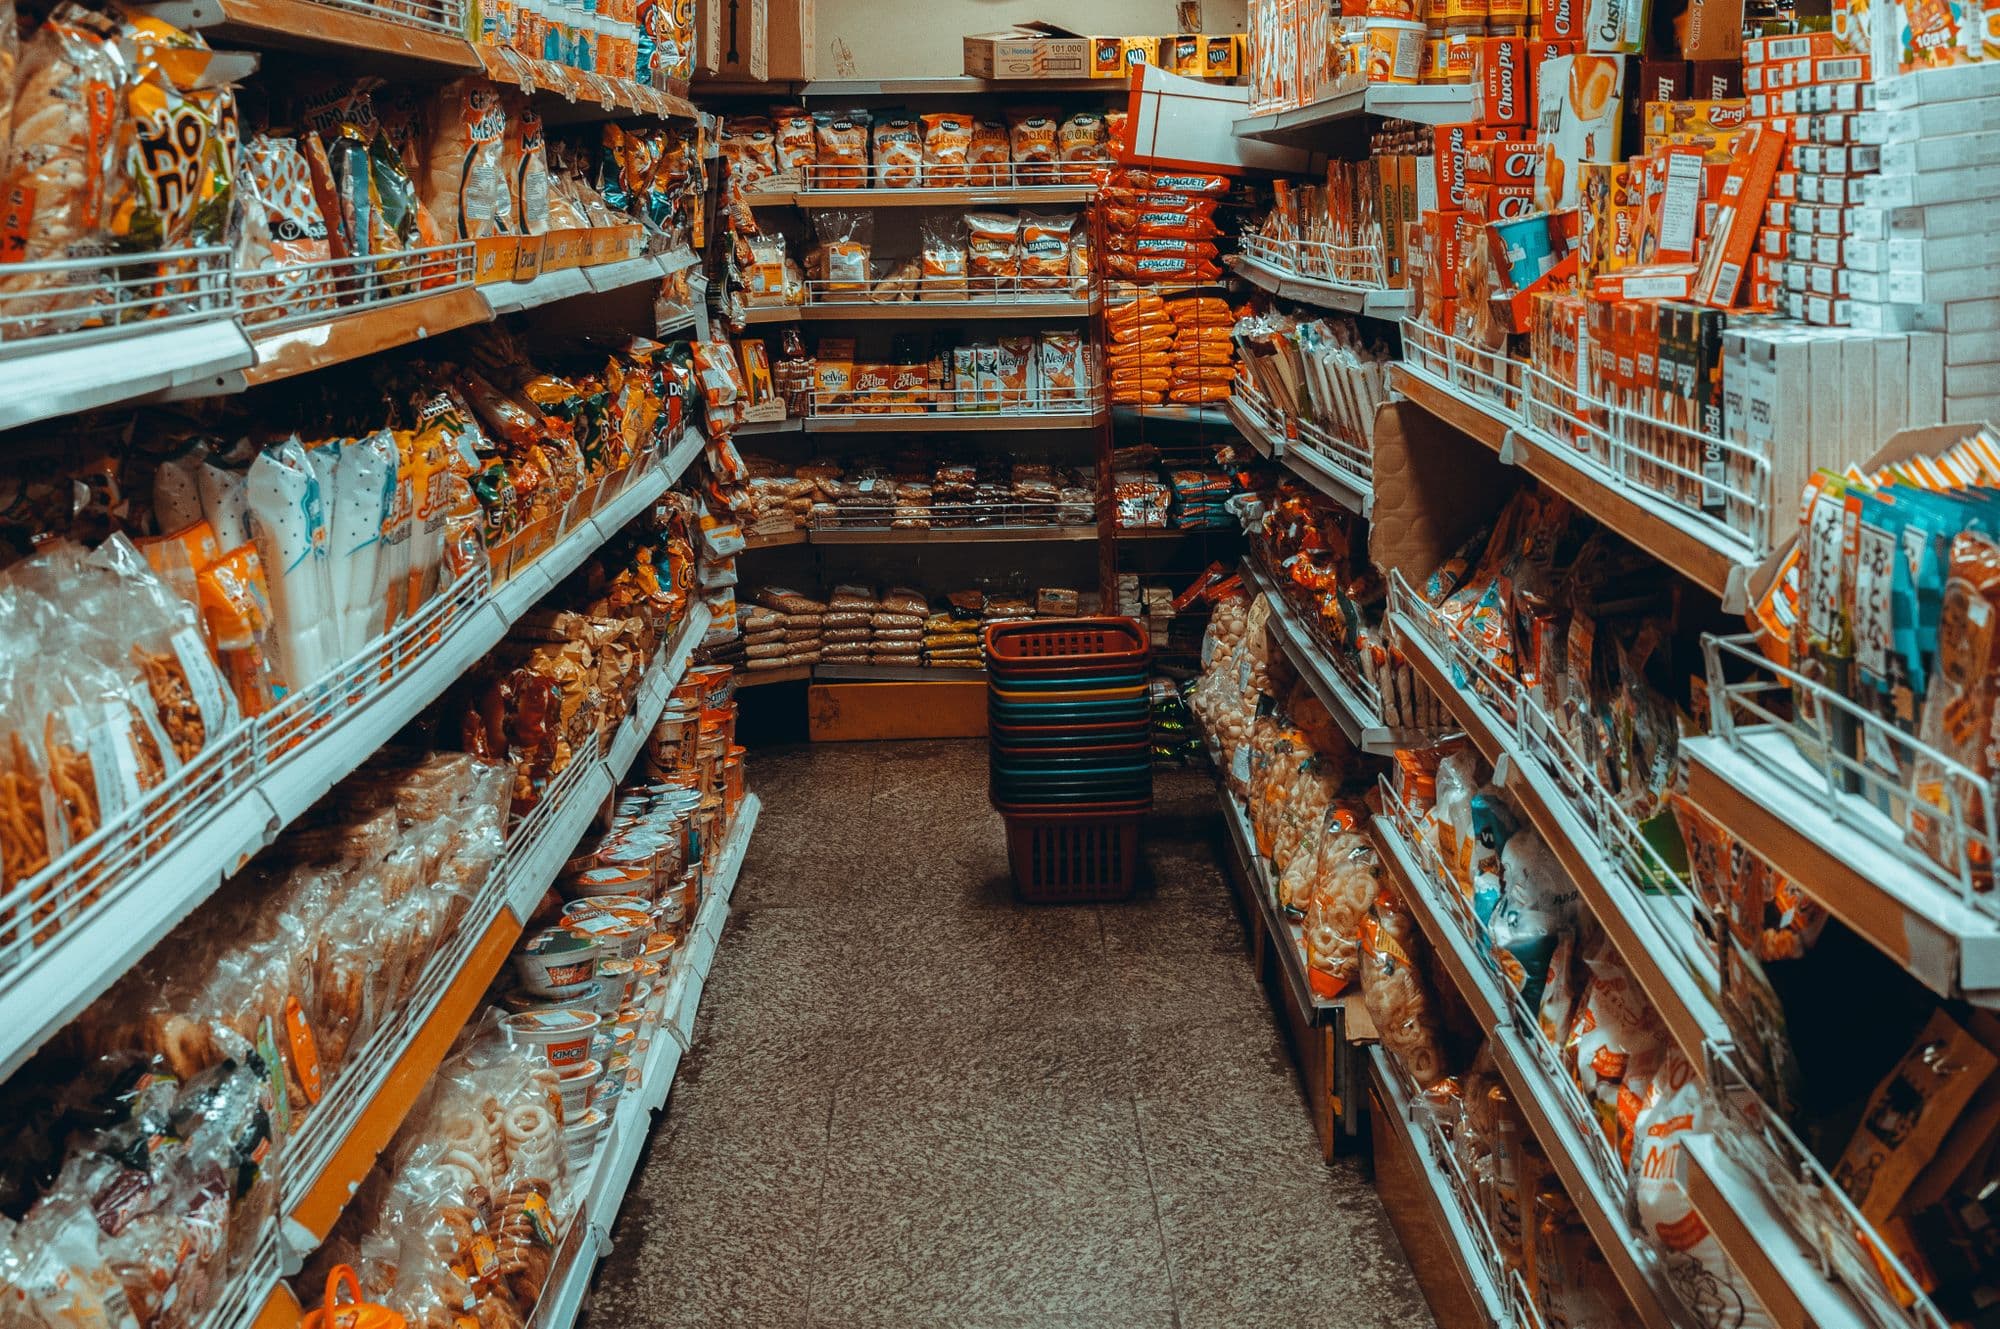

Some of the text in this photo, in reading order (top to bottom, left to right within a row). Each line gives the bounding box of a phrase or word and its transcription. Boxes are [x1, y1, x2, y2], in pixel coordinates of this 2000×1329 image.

[1127, 48, 1145, 64] MID
[1208, 49, 1225, 62] MID
[1489, 66, 1497, 97] LOTTE
[1497, 70, 1514, 120] Choco
[1442, 152, 1450, 183] LOTTE
[1156, 177, 1207, 188] ESPAGUETE
[1498, 187, 1533, 195] LOTTE
[1028, 241, 1061, 251] MANINHO
[1446, 241, 1454, 270] LOTTE
[1137, 258, 1186, 269] ESPAGUETE
[999, 355, 1026, 367] Nesfit
[1045, 352, 1074, 366] Nesfit
